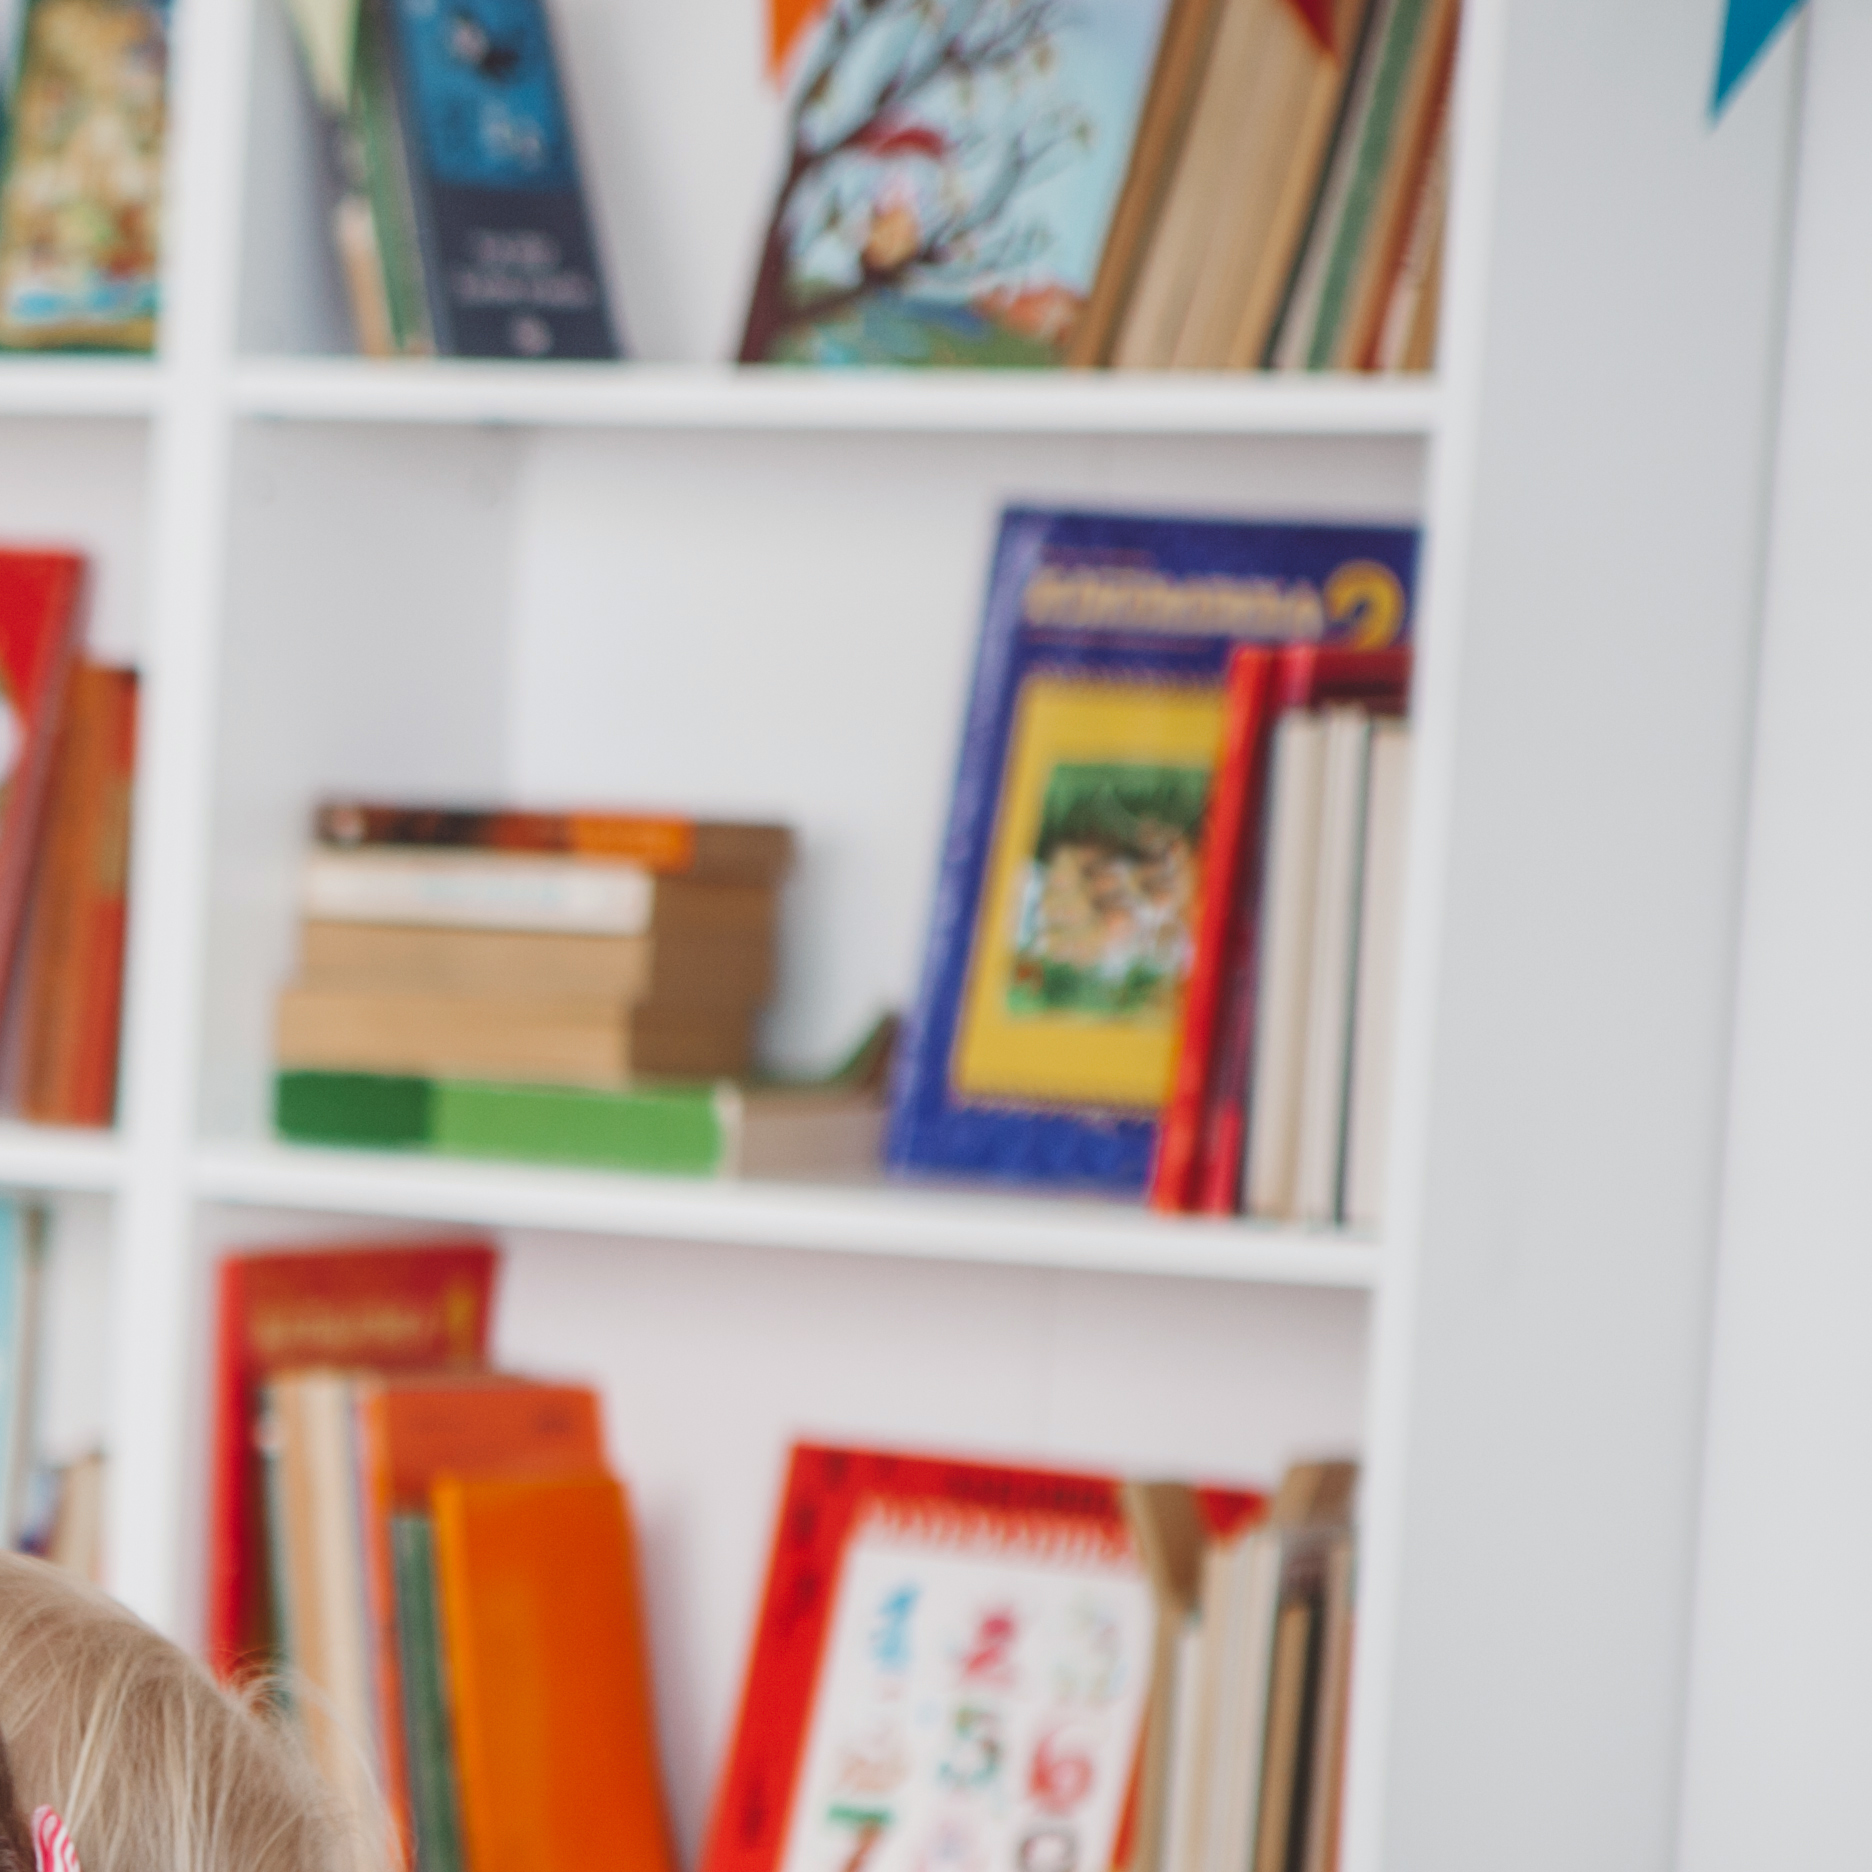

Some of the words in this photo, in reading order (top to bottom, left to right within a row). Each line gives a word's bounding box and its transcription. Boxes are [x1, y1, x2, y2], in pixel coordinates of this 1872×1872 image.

[868, 1580, 921, 1672] 1
[958, 1603, 1019, 1688] 2
[938, 1703, 1003, 1791] 5
[1024, 1708, 1095, 1816] 6
